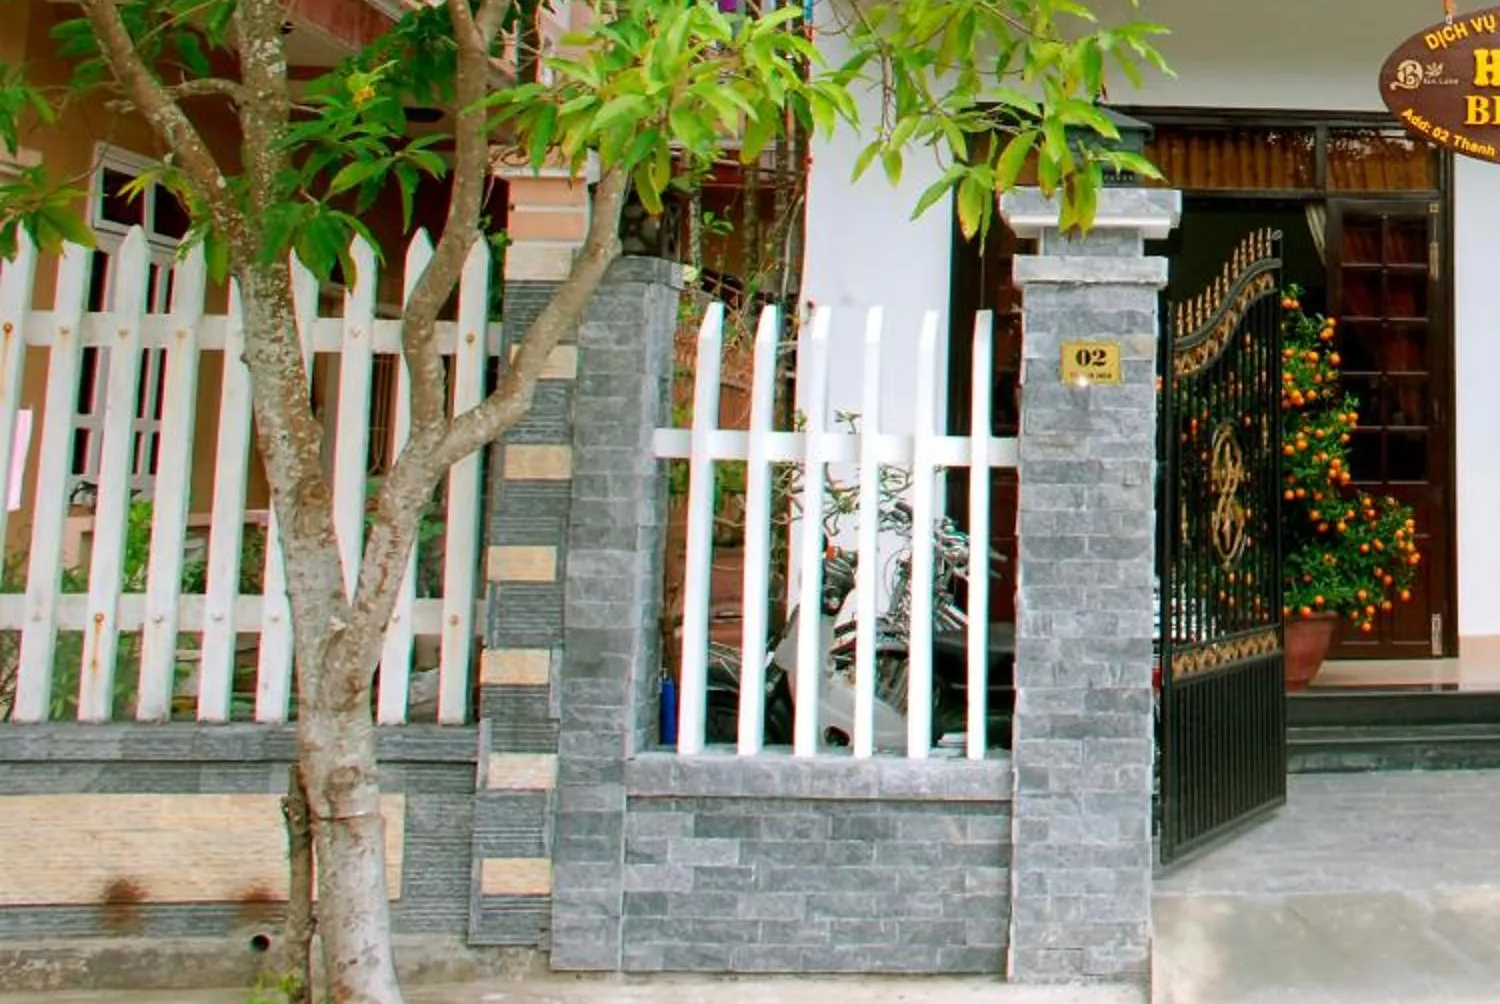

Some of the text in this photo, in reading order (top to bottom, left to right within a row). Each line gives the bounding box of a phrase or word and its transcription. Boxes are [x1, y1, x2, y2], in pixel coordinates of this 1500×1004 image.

[1424, 24, 1469, 49] DỊCH
[1470, 14, 1496, 33] VỤ
[1402, 108, 1431, 134] Add:
[1432, 126, 1449, 143] 02
[1453, 134, 1495, 157] Thanh
[1075, 349, 1107, 367] 02
